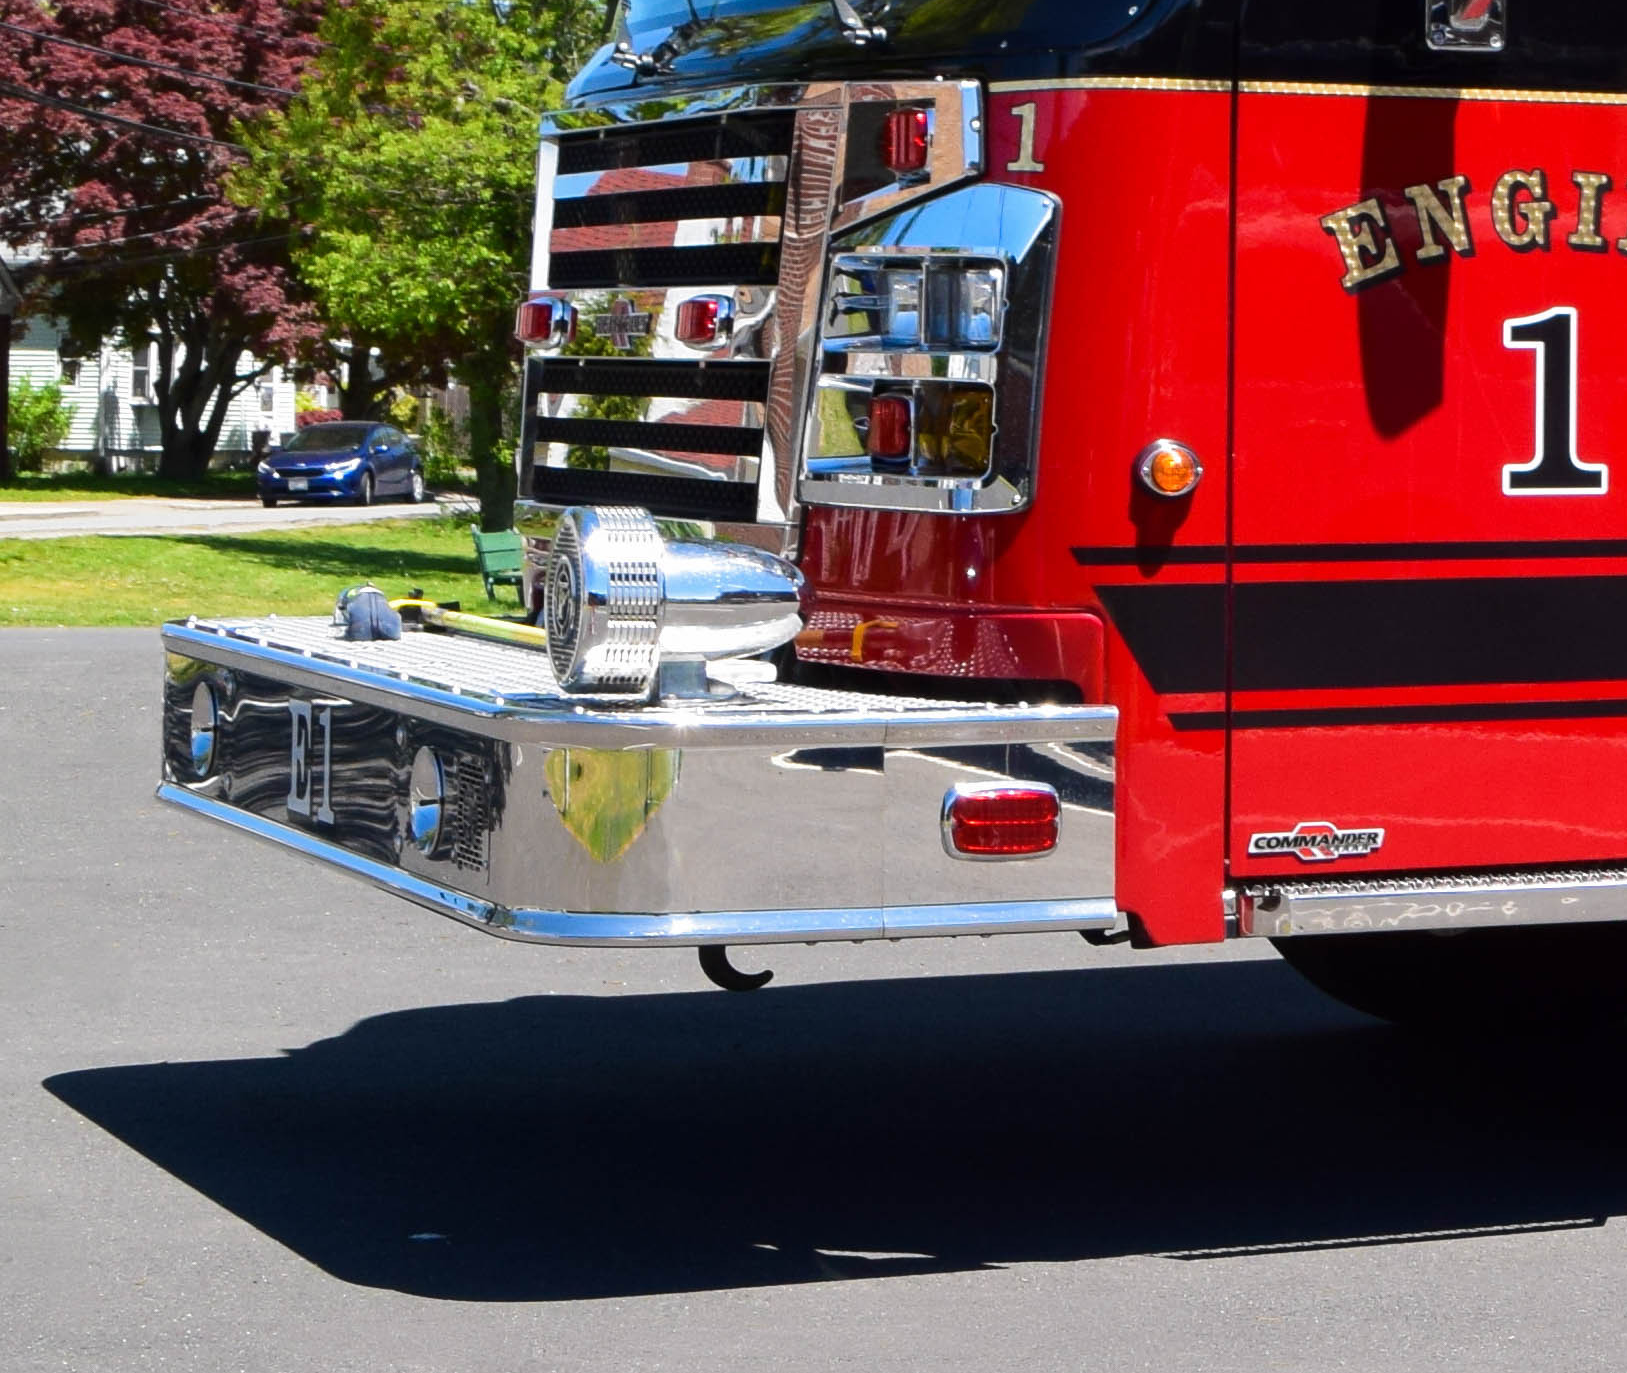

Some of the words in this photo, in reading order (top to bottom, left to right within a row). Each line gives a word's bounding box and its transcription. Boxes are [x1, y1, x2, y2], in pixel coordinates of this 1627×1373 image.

[1006, 102, 1045, 173] 1
[1502, 306, 1608, 496] 1
[287, 698, 335, 825] E1
[1253, 831, 1380, 850] COMMANDER
